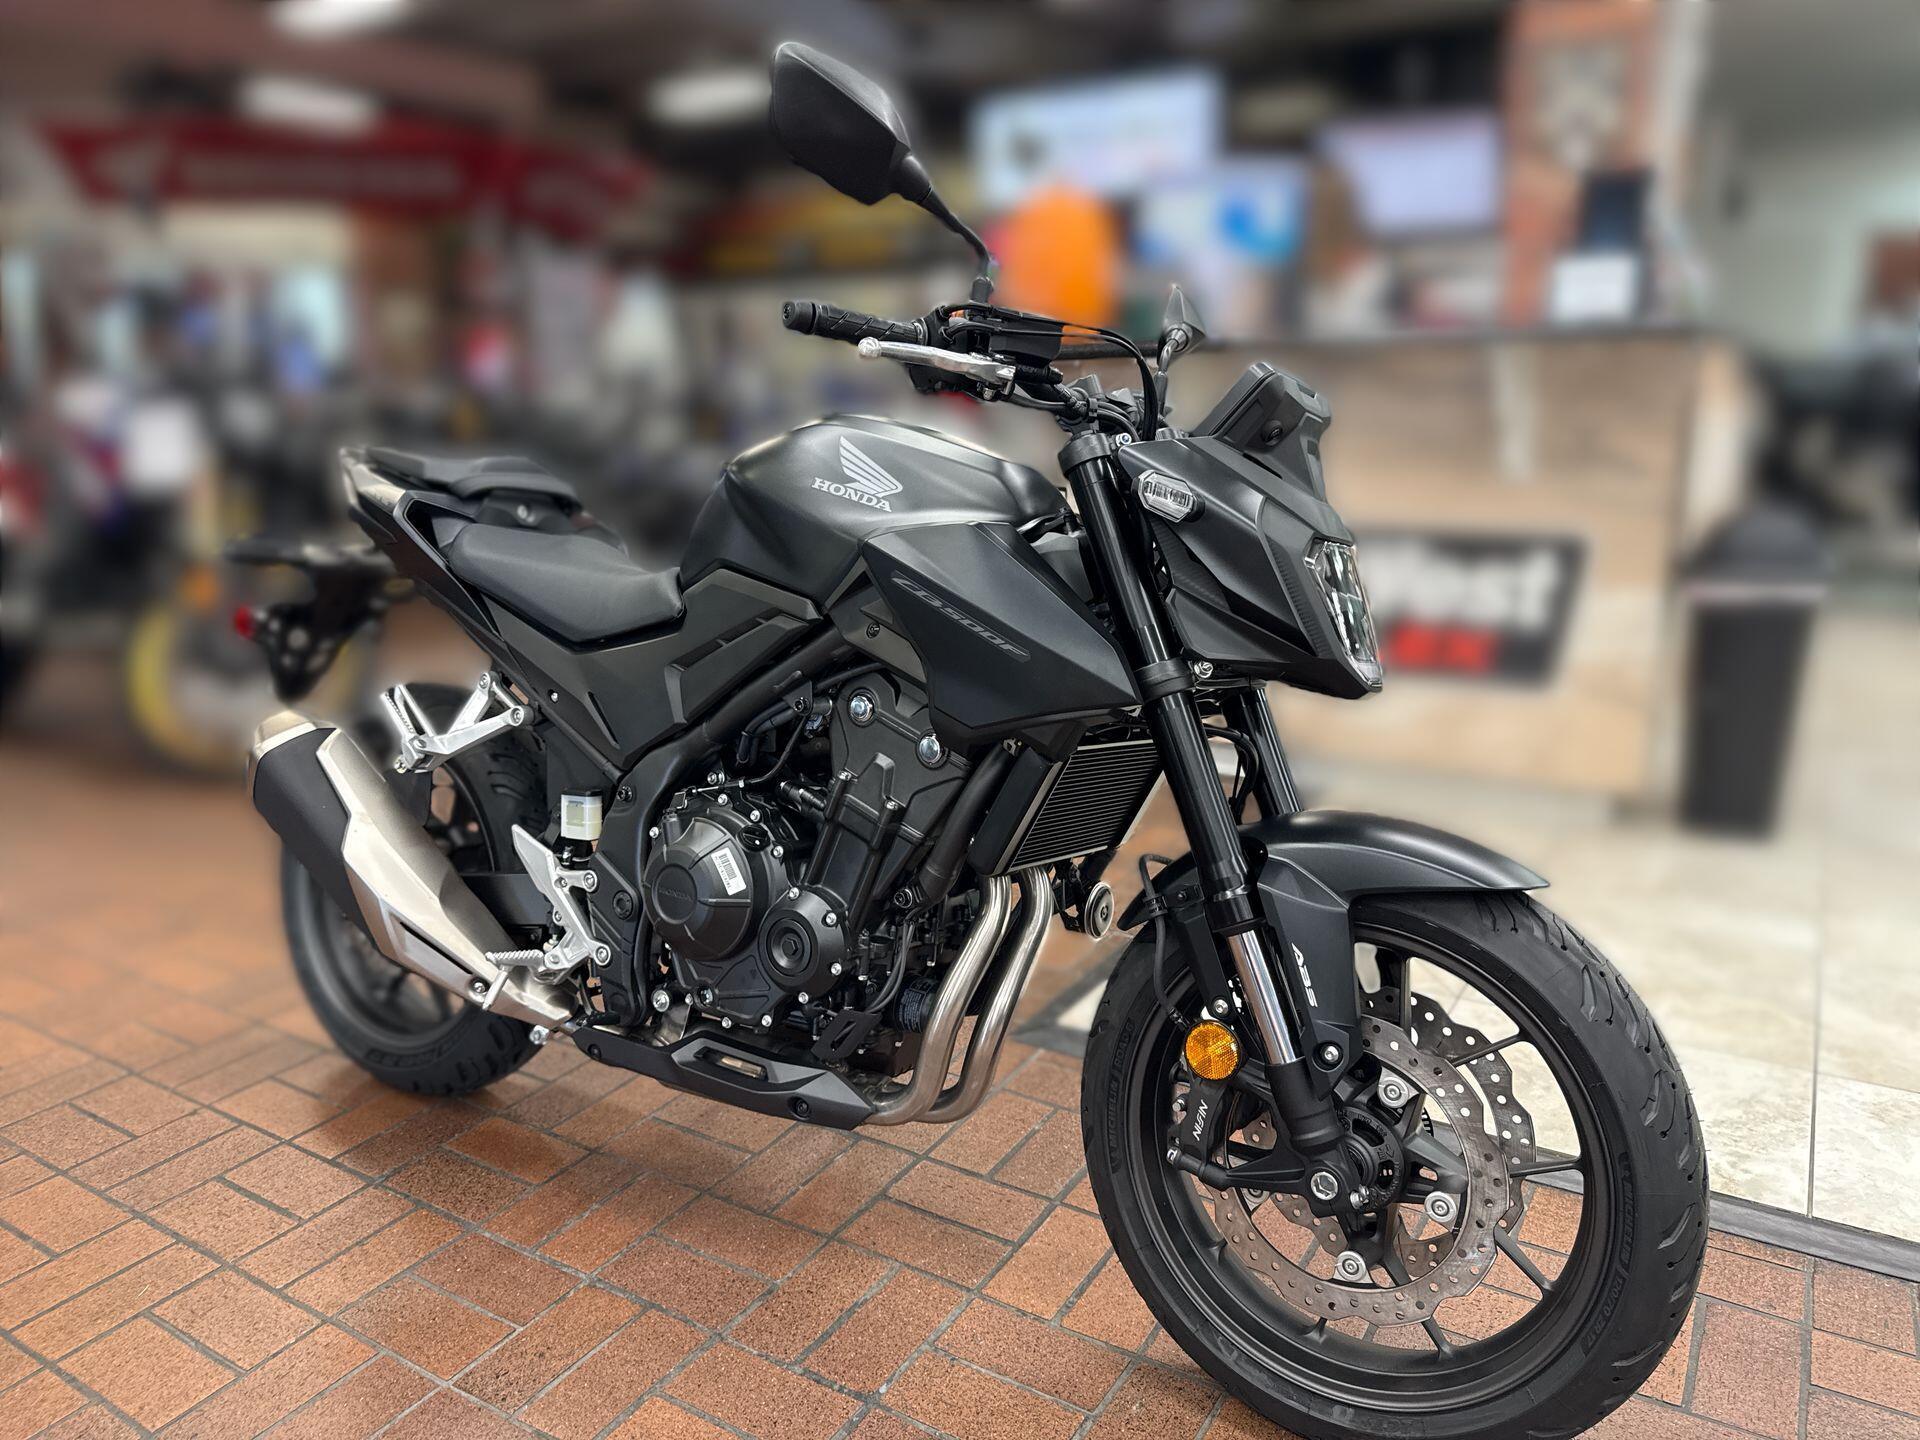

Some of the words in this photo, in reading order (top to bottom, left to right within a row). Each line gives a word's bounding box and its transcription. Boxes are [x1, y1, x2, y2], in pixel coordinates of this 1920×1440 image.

[811, 477, 892, 512] HONDA
[891, 576, 1030, 658] CB500F
[1291, 942, 1318, 1008] ABS
[1108, 1079, 1119, 1149] MICHELIN
[1192, 1099, 1208, 1141] NISSIN
[1621, 1181, 1634, 1265] MICHELIN
